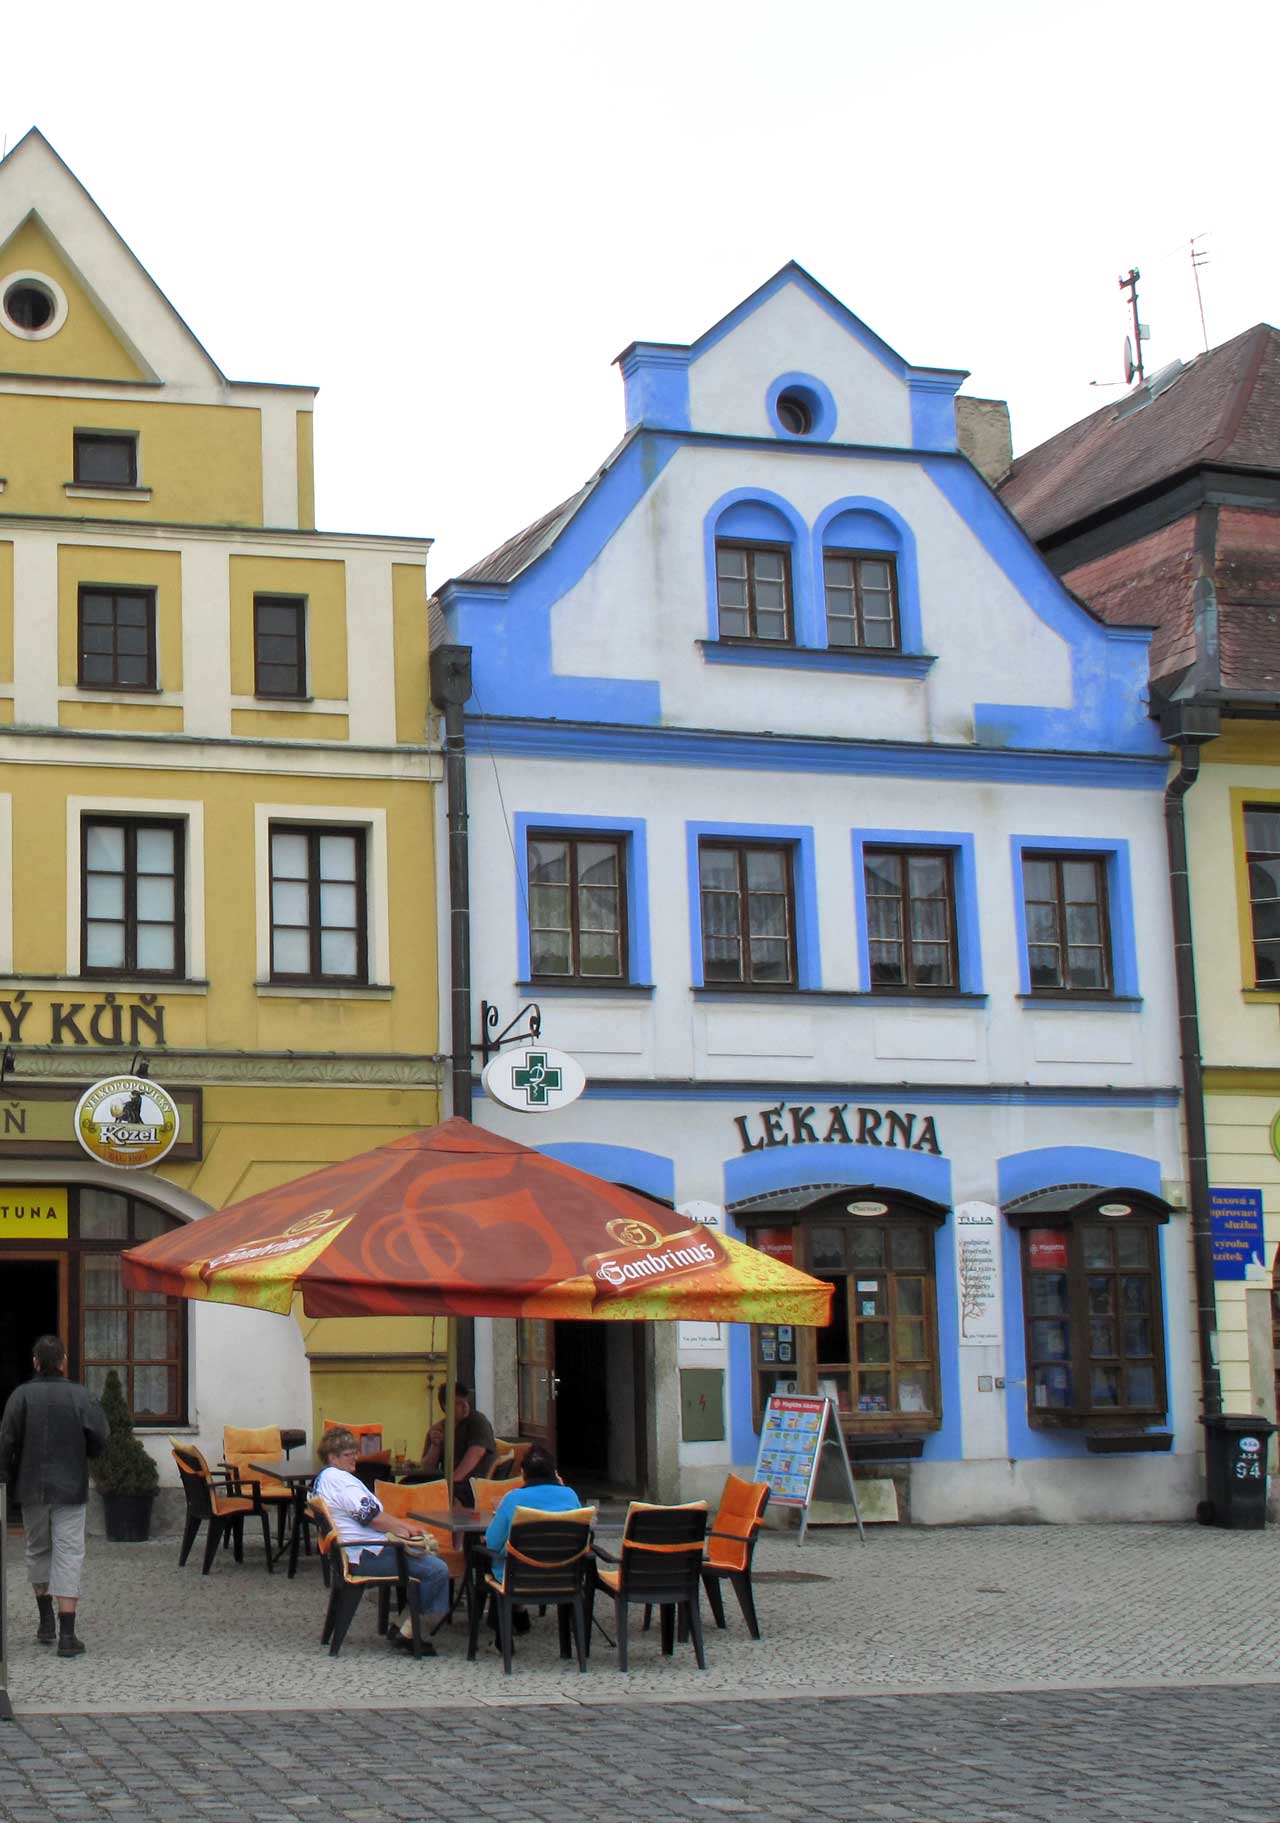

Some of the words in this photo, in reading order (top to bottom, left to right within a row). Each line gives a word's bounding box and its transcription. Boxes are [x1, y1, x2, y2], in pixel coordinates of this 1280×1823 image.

[50, 992, 167, 1046] KŮŇ
[99, 1125, 161, 1145] Kozel
[734, 1102, 943, 1155] LÉKÁRNA
[596, 1243, 715, 1285] Gambrinus
